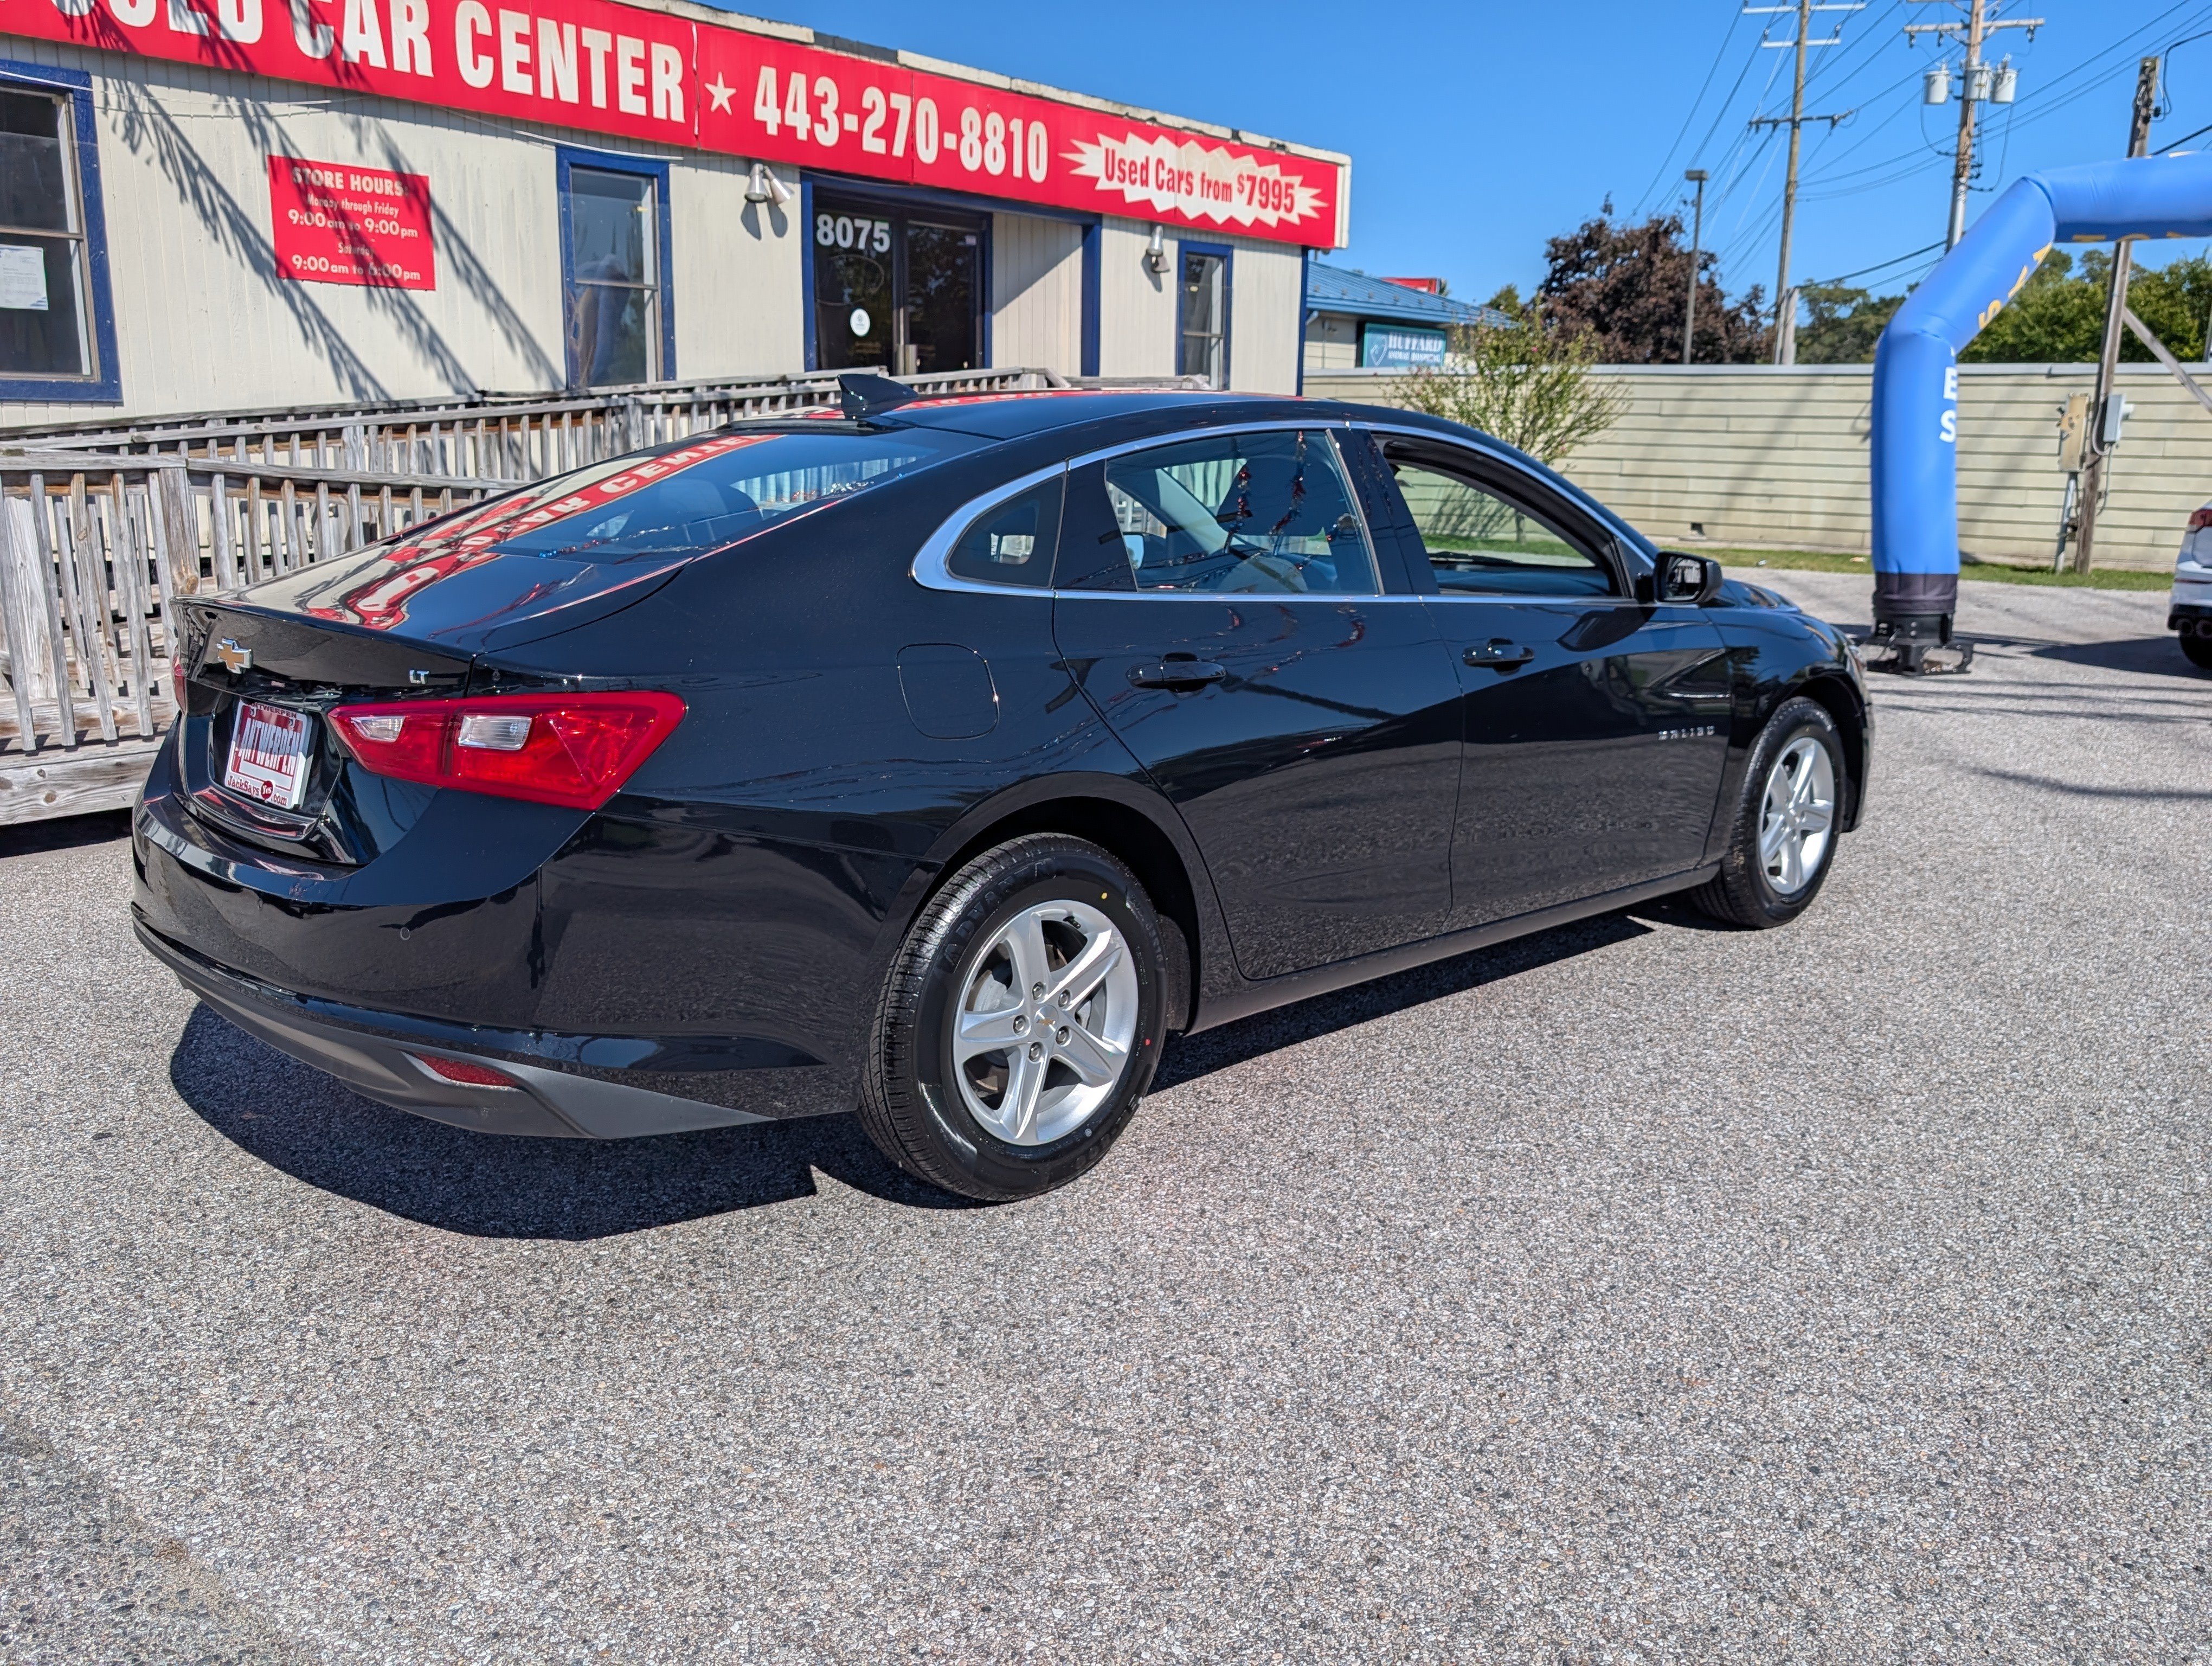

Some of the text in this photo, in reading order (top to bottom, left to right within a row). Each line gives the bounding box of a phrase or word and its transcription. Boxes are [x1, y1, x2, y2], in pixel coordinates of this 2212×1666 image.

[294, 0, 434, 77] CAR
[456, 0, 685, 123] CENTER
[754, 65, 1049, 183] 443-270-8810
[292, 167, 409, 197] STORE HOURS:
[1103, 146, 1296, 215] Used Cars from $7995
[307, 193, 400, 218] Monday through Friday
[349, 220, 361, 232] to
[816, 214, 891, 253] 8075
[338, 241, 374, 259] Saturday
[352, 266, 363, 275] to
[409, 669, 430, 684] LT
[238, 717, 300, 776] ANTWERPEN
